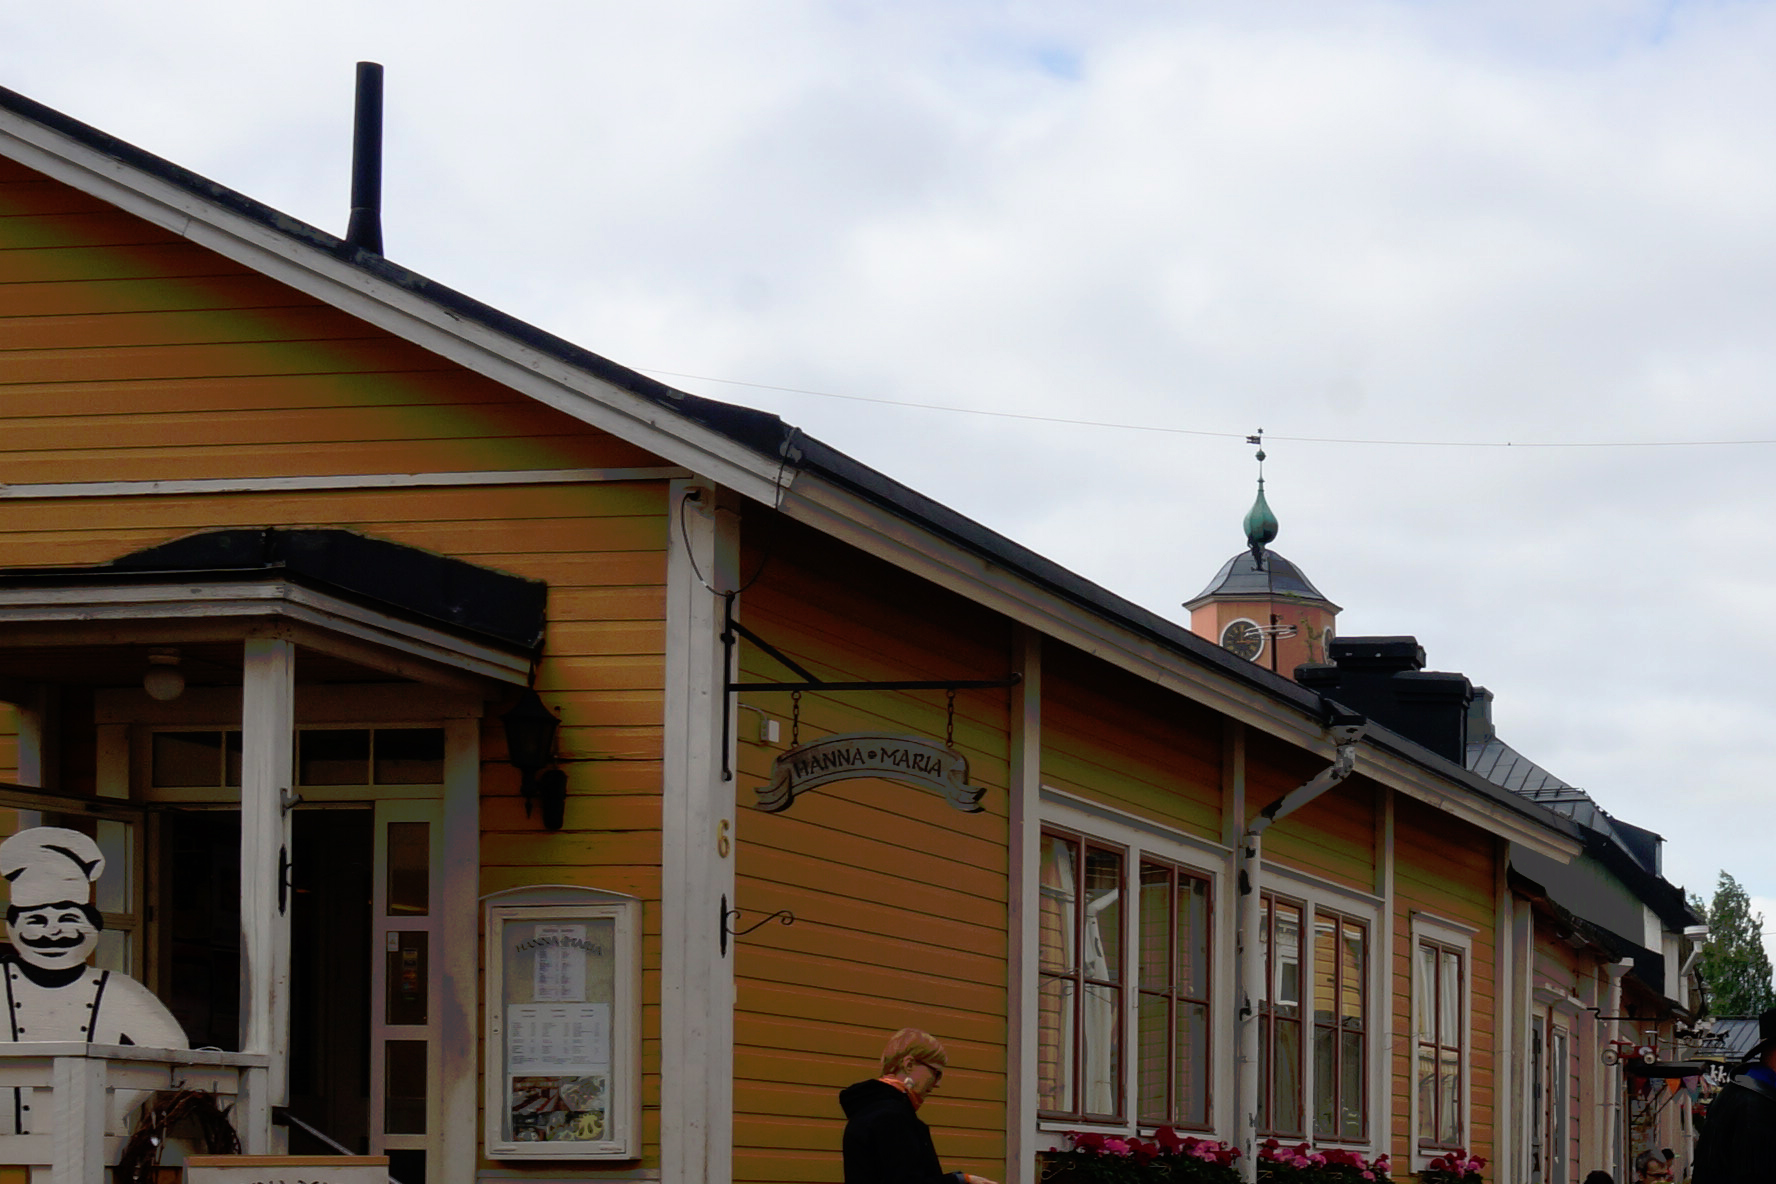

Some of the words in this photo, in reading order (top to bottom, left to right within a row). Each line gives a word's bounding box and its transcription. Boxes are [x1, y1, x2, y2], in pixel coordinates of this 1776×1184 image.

[793, 748, 866, 779] HANNA
[881, 747, 942, 777] MARIA
[717, 819, 730, 859] 6
